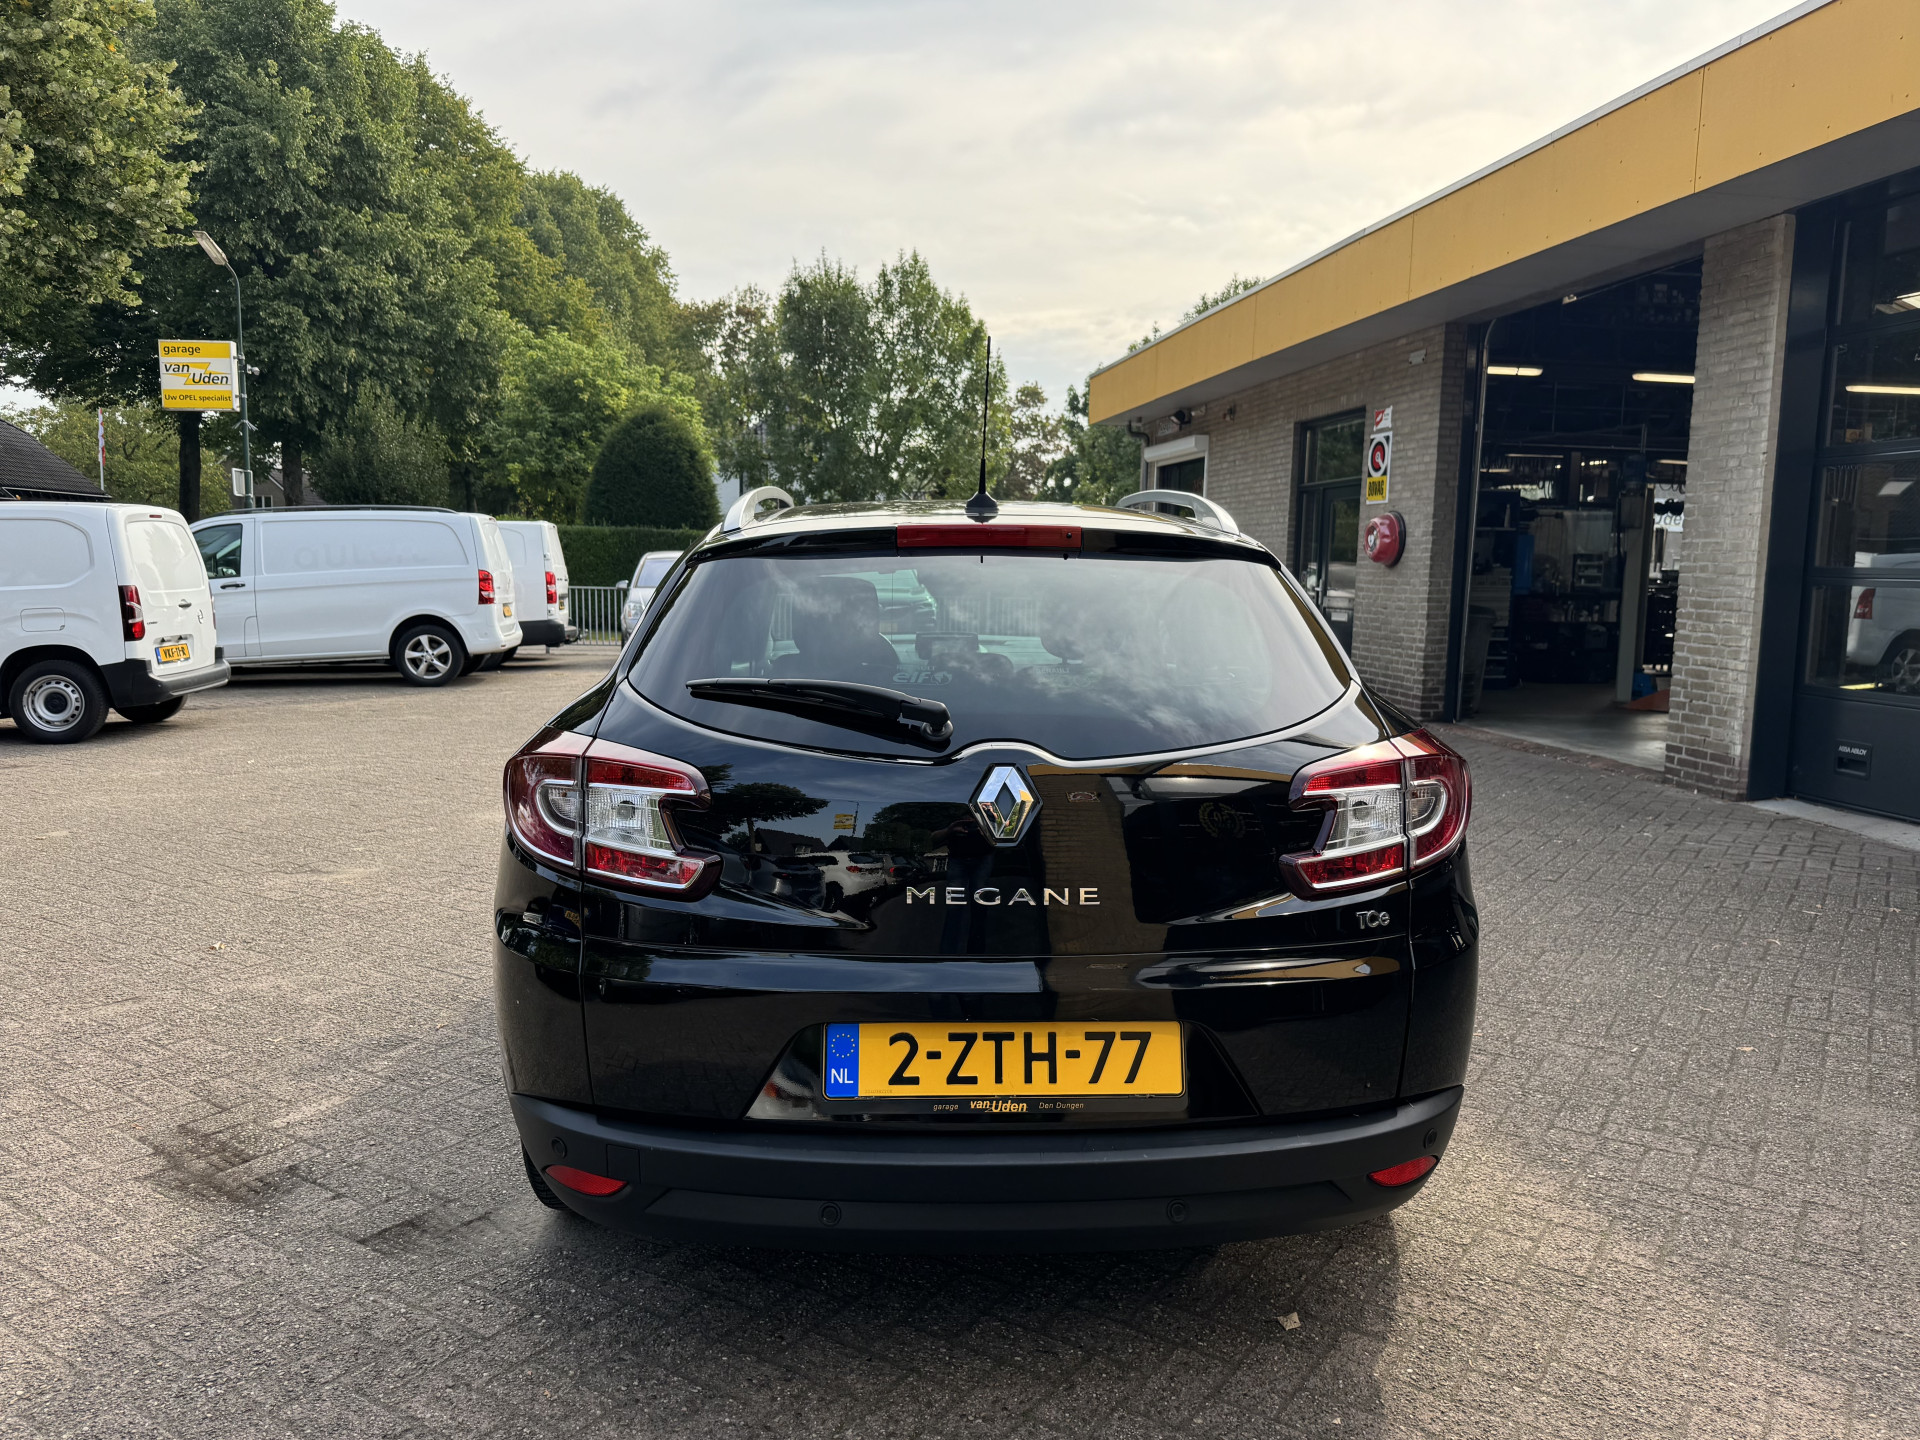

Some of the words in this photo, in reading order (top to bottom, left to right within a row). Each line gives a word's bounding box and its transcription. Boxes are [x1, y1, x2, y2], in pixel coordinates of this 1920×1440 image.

[163, 345, 201, 355] garage
[164, 363, 190, 373] van
[192, 372, 229, 385] Uden
[199, 394, 232, 402] specialist
[1367, 479, 1385, 497] BOVAG
[906, 886, 1101, 906] MEGANE
[1356, 909, 1391, 930] TCe
[888, 1031, 1152, 1086] 2-ZTH-77
[831, 1068, 854, 1084] NL
[933, 1103, 959, 1111] garage
[970, 1100, 990, 1109] van
[991, 1100, 1027, 1113] Uden
[1038, 1101, 1054, 1109] Den
[1055, 1101, 1085, 1110] Dungen
